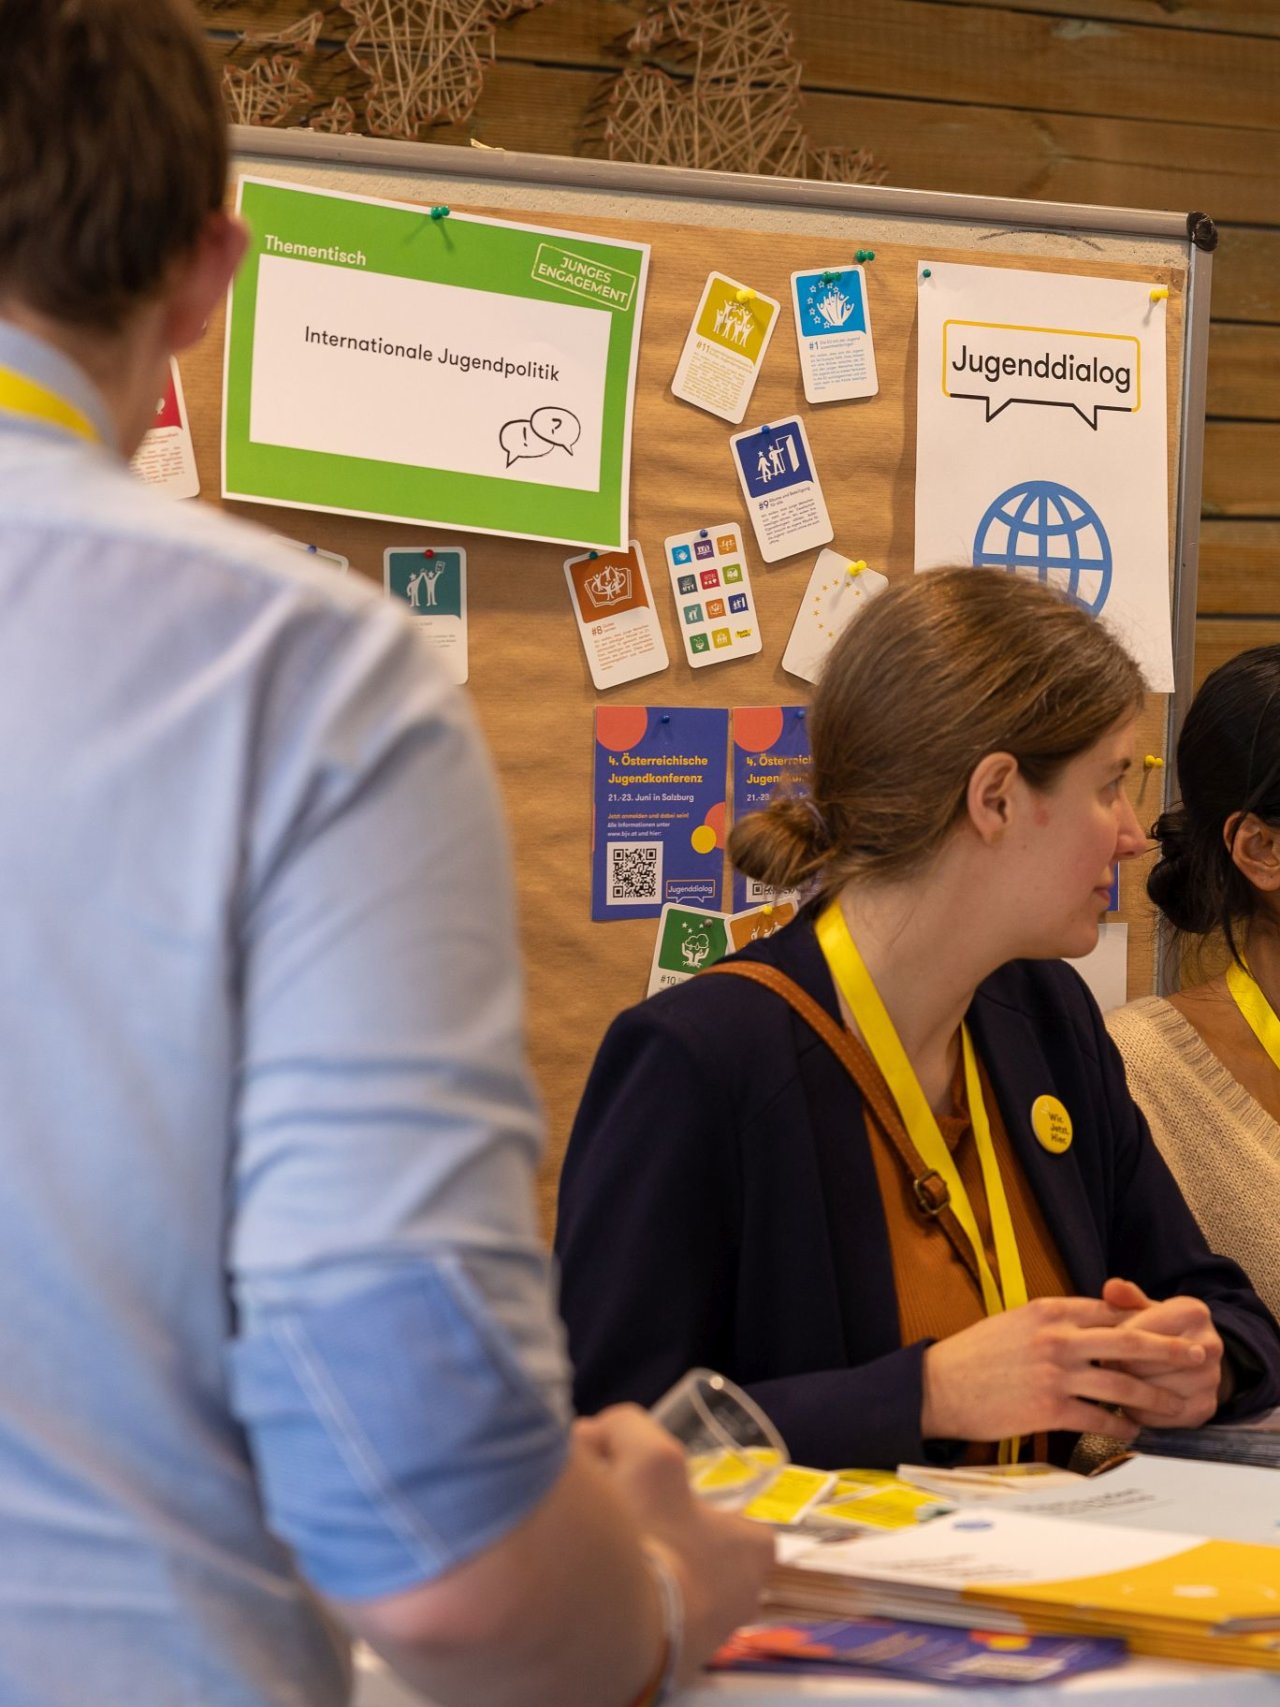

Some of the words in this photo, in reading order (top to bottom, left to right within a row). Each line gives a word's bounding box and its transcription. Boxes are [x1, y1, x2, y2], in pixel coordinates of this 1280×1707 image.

[264, 234, 366, 266] Thementisch
[560, 256, 612, 284] JUNGES
[537, 263, 629, 304] ENGAGEMENT
[304, 325, 433, 362] Internationale
[438, 347, 560, 383] Jugendpolitik
[952, 345, 1131, 393] Jugenddialog
[608, 755, 619, 766] 4.
[621, 752, 708, 766] Österreichische
[746, 756, 756, 766] 4.
[608, 773, 703, 786] Jugendkonferenz
[608, 793, 634, 802] 21.-23.
[635, 793, 651, 801] Juni
[662, 793, 694, 803] Salzburg
[746, 793, 770, 802] 21.-23
[668, 885, 713, 895] Jugenddialog
